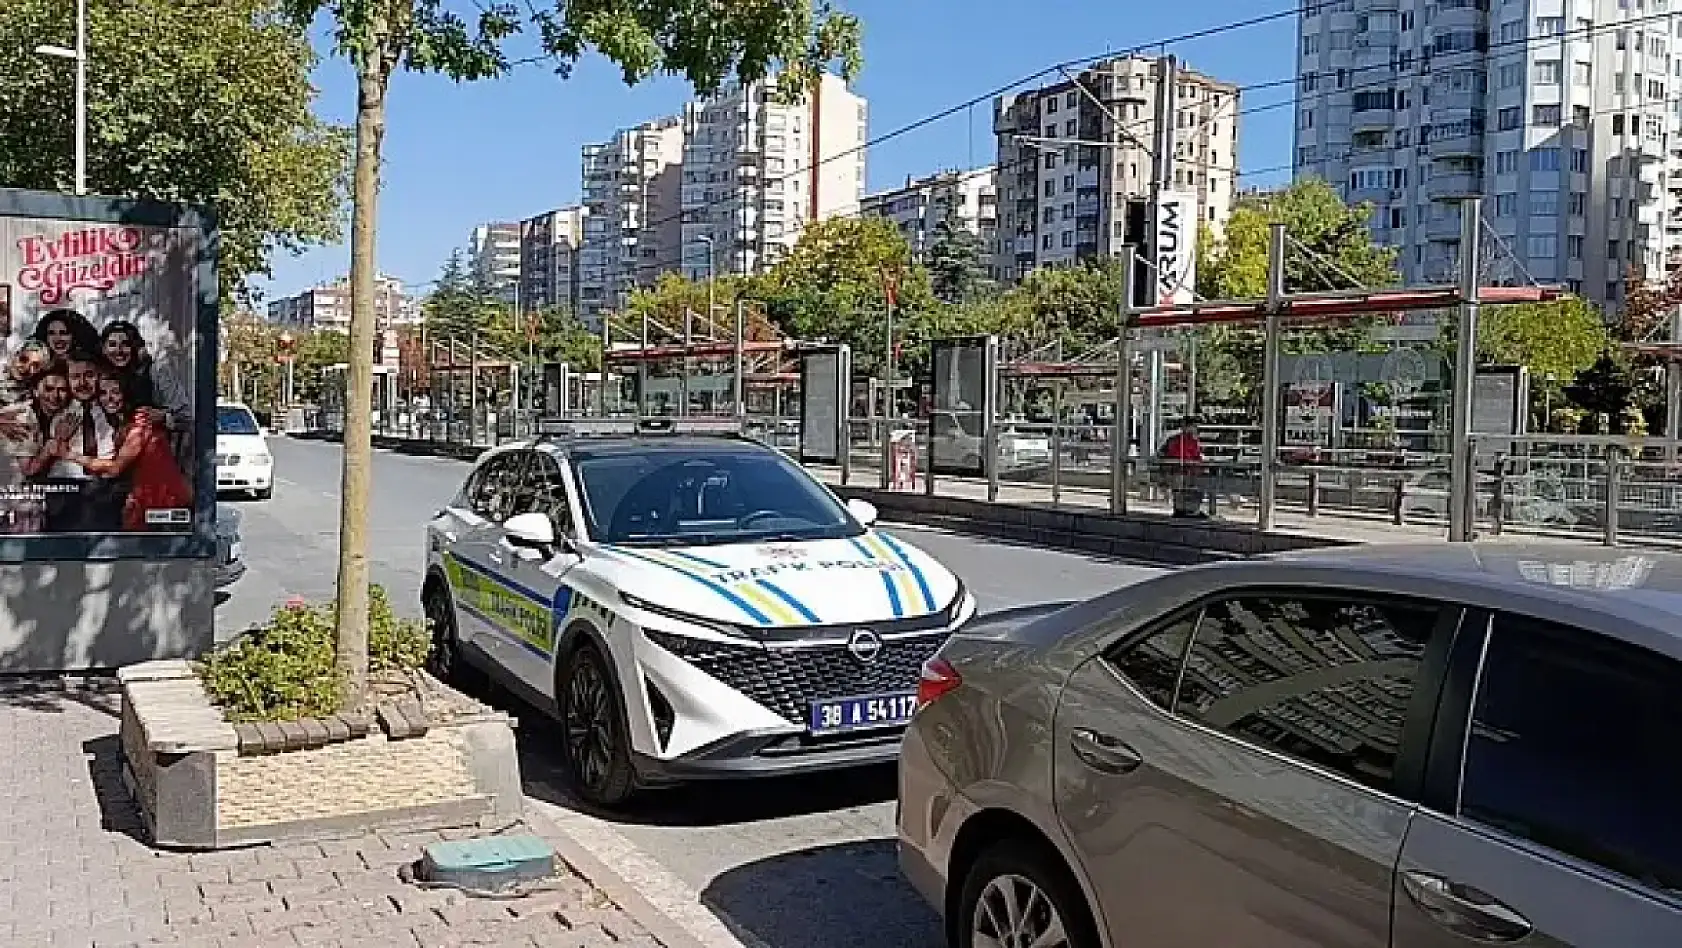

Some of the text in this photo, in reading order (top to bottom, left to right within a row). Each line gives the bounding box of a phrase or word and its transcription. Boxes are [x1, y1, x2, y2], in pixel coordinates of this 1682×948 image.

[17, 227, 142, 264] Evlilik
[1159, 201, 1179, 306] KARUM
[17, 254, 146, 304] Güzeldir
[852, 702, 863, 724] A
